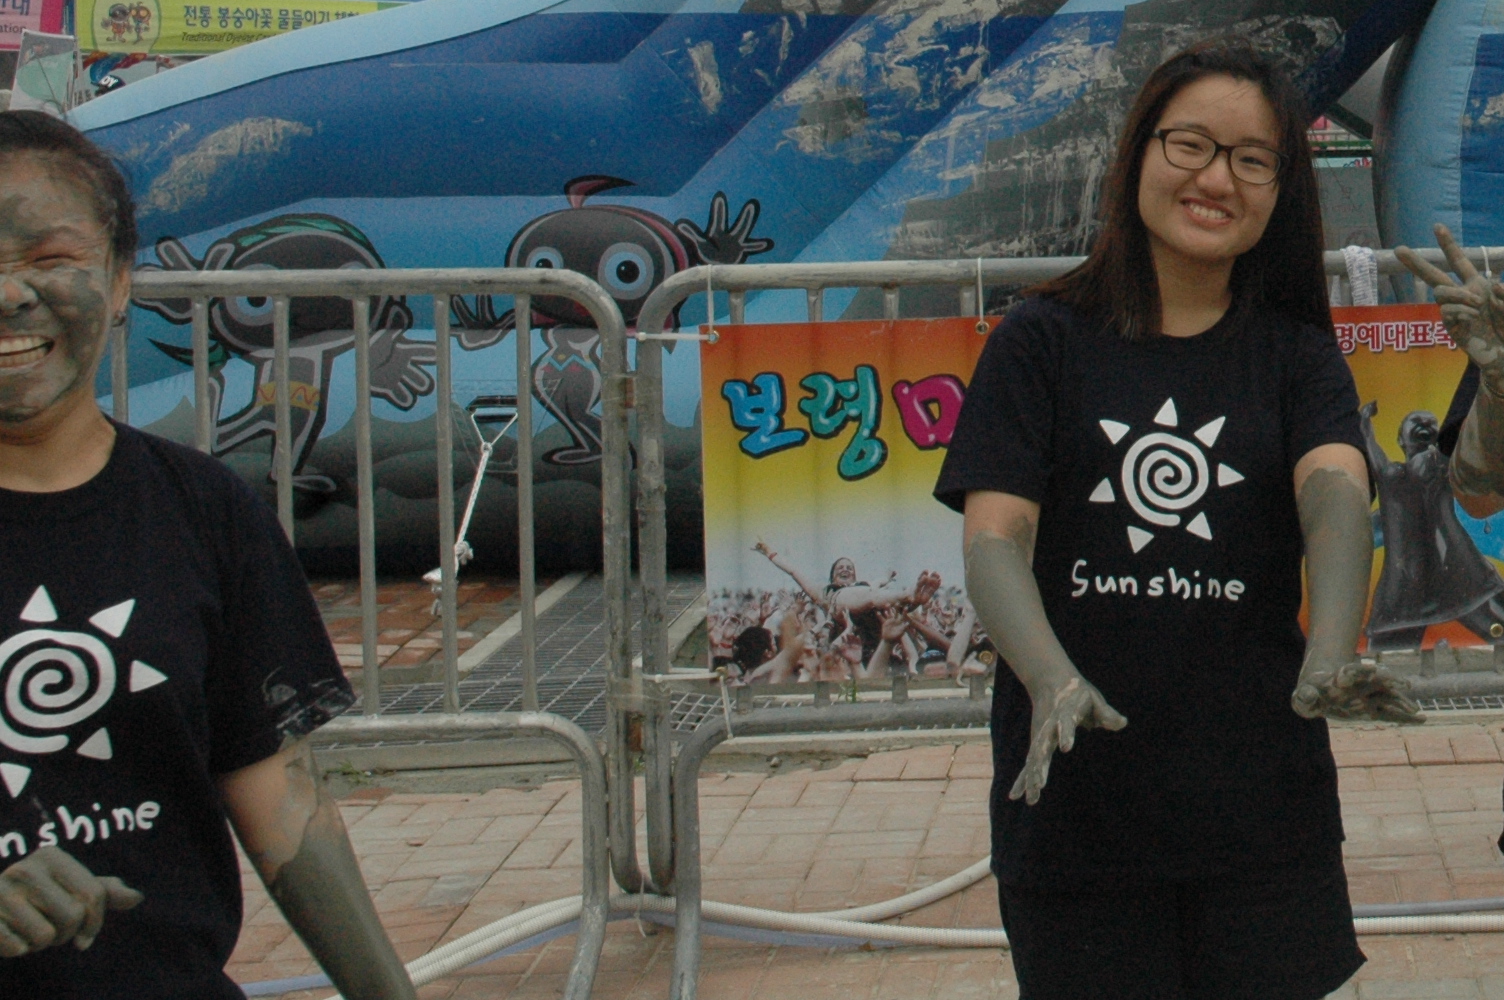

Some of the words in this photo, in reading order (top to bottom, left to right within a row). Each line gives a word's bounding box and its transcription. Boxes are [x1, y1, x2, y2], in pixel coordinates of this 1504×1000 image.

[184, 5, 212, 28] 전통
[217, 7, 273, 29] 봉숭아꽃
[721, 364, 889, 482] 보령
[1071, 559, 1245, 601] Sunshine
